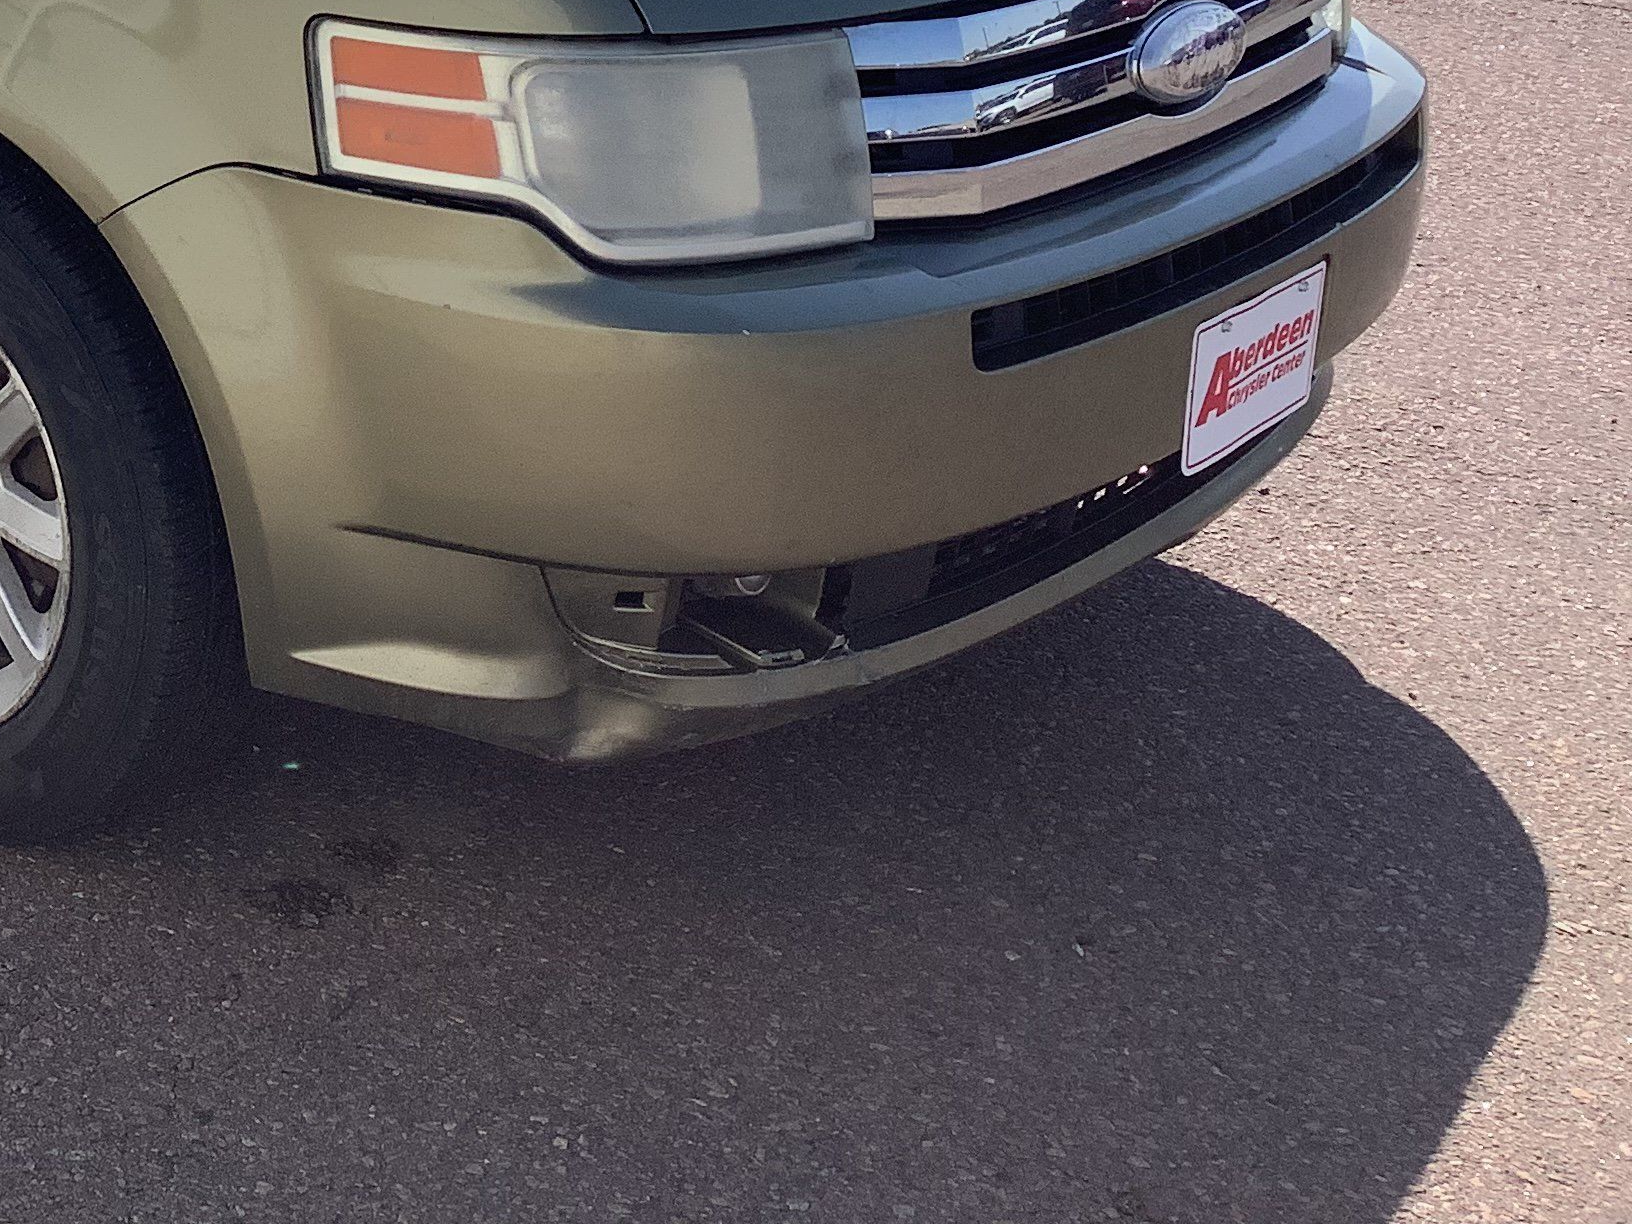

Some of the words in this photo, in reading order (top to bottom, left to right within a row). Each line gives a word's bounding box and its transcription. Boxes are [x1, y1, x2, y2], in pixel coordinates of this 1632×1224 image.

[1195, 309, 1315, 428] Aberdeen
[1227, 371, 1271, 410] Chrysler
[1272, 350, 1306, 382] Center
